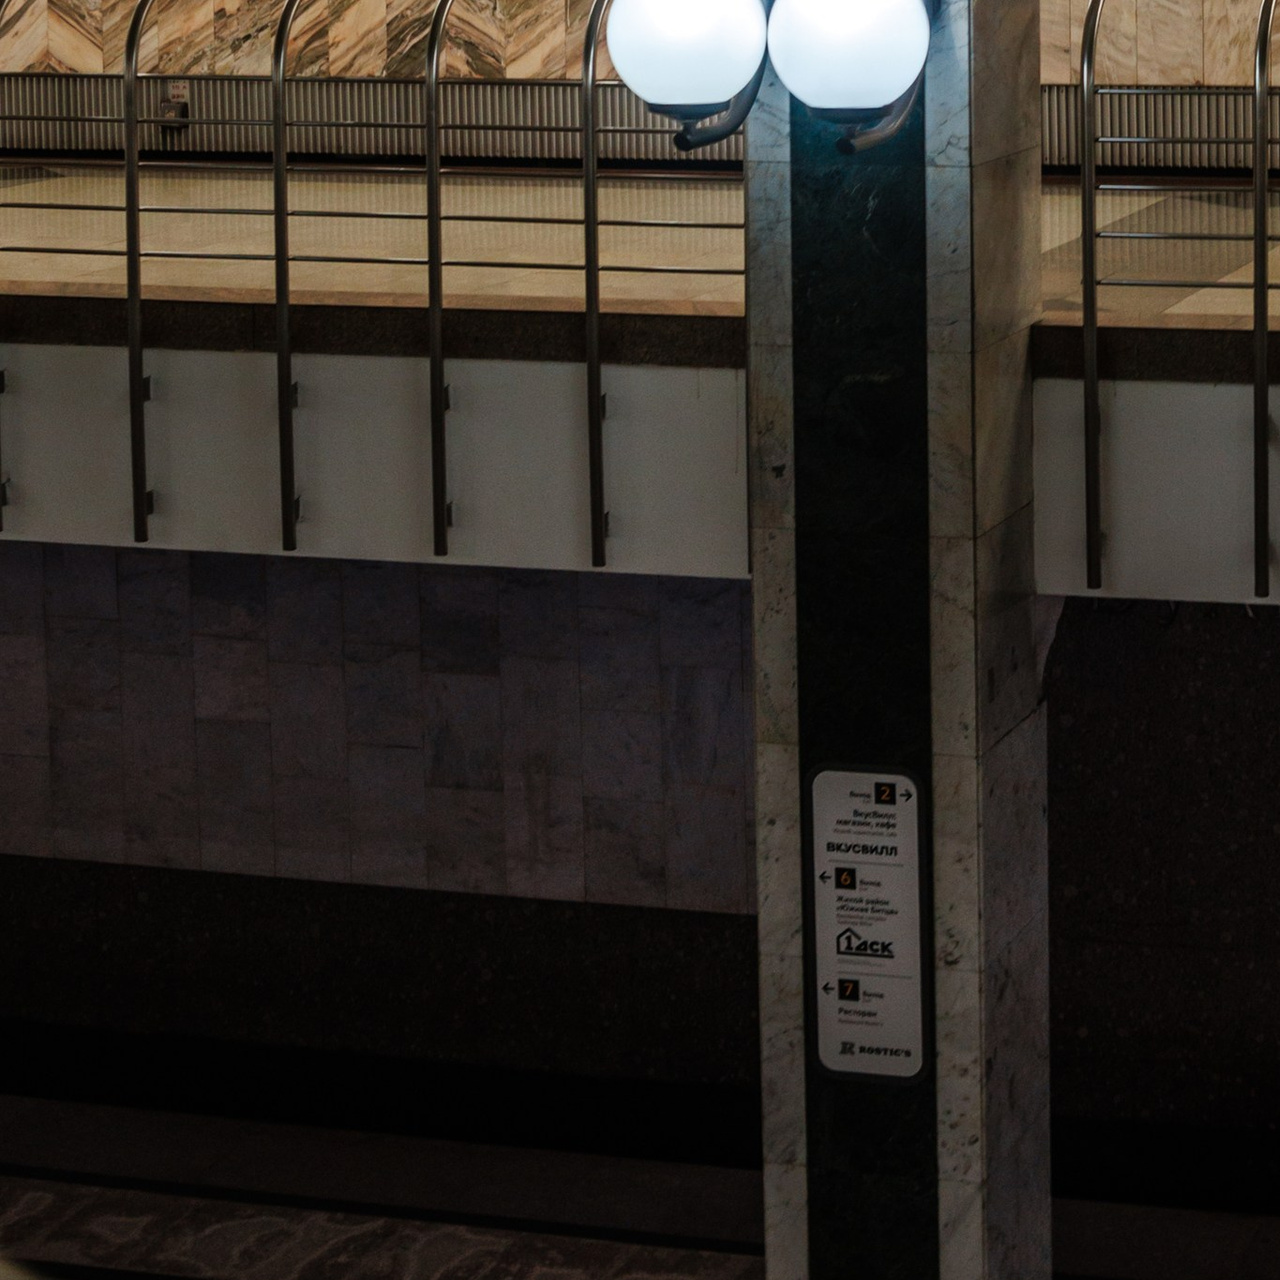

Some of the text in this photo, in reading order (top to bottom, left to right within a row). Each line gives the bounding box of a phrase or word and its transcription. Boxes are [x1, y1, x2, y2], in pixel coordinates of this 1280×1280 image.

[880, 785, 891, 801] 2
[875, 821, 897, 831] кафе
[826, 841, 898, 857] ВКУСВИЛЛ
[840, 870, 851, 886] 6
[843, 982, 854, 997] 7
[838, 1007, 878, 1018] Ресторан
[858, 1045, 912, 1058] ROSTIC'S
